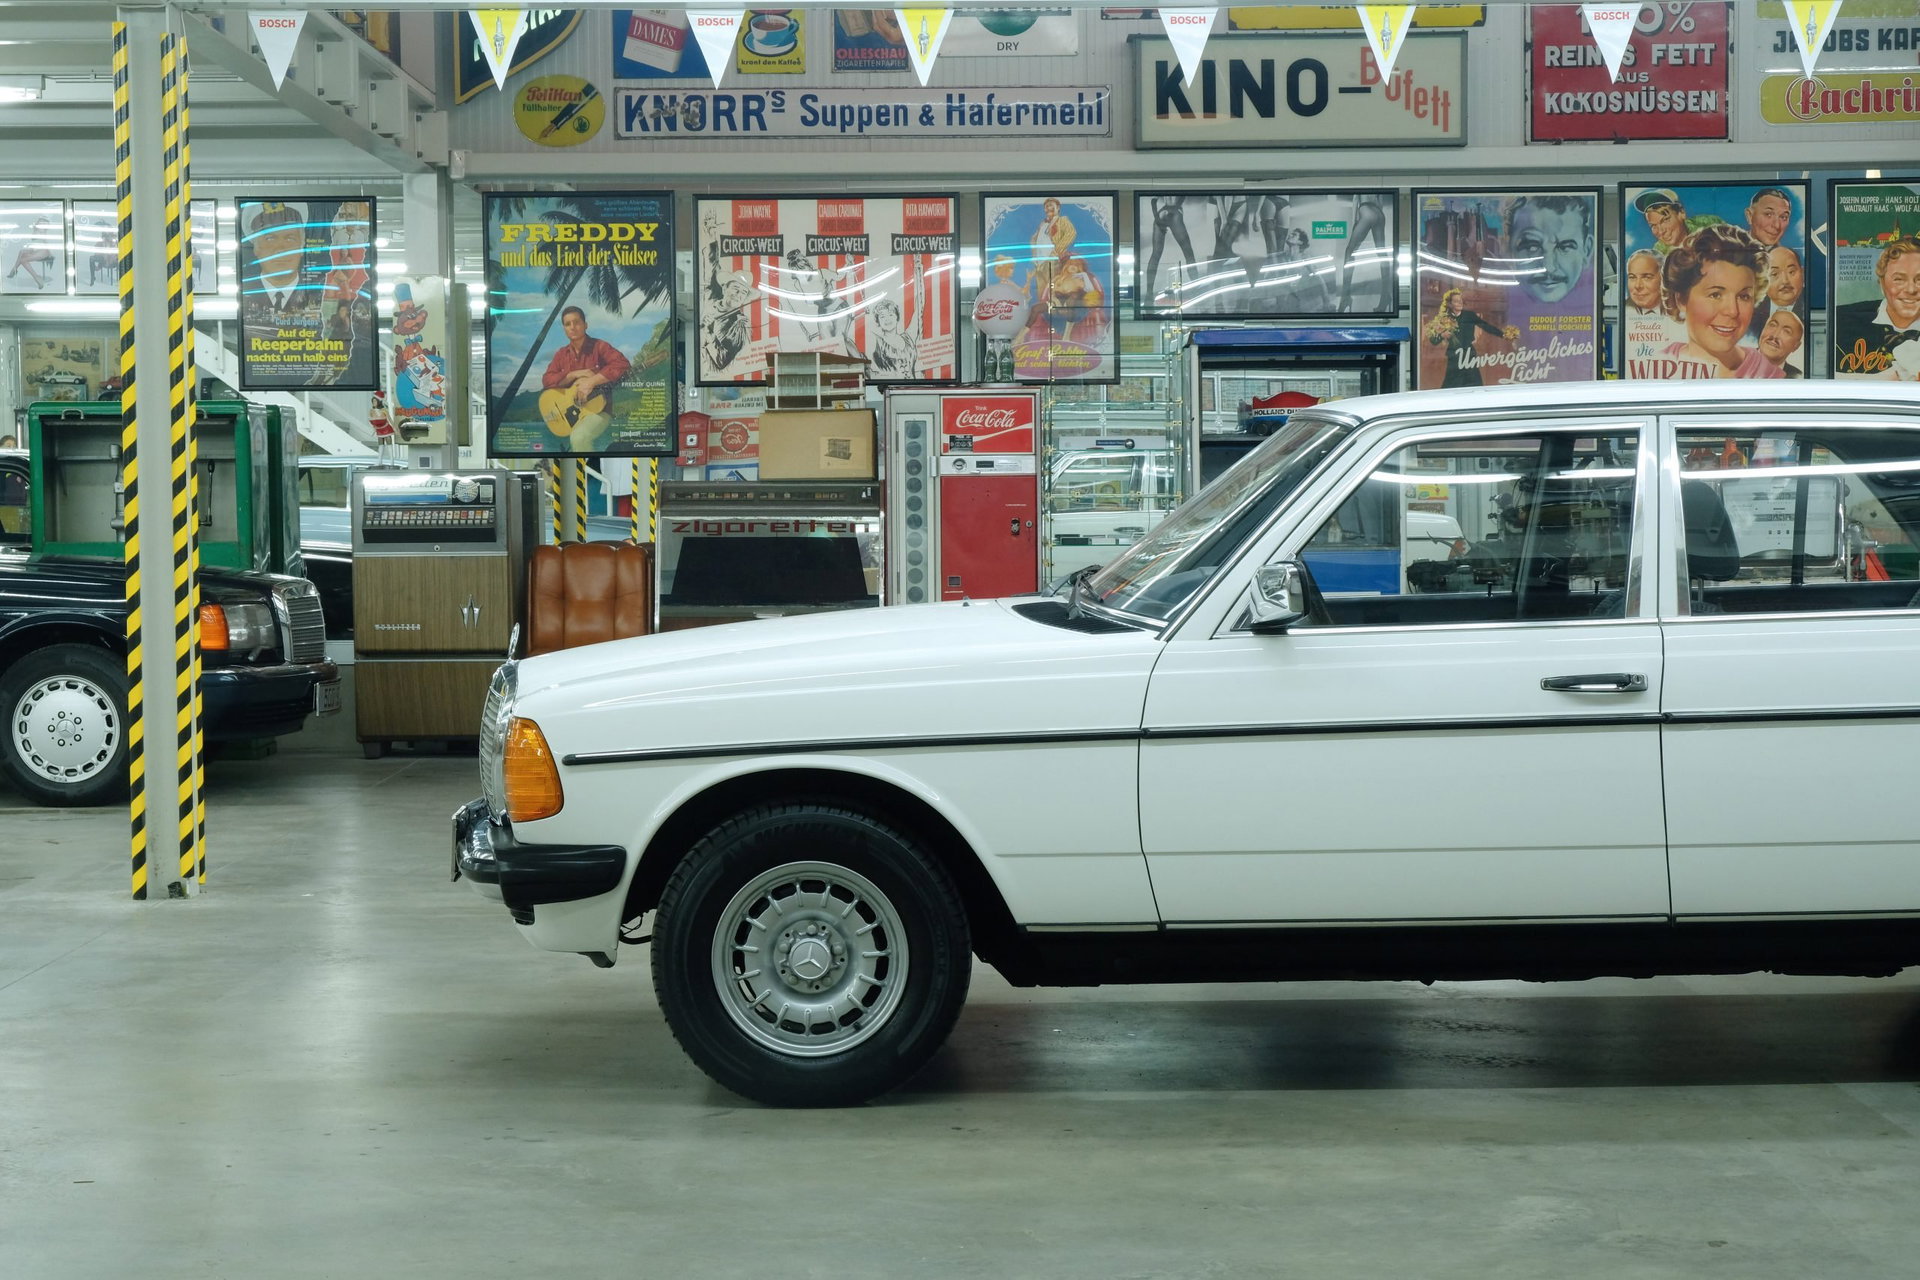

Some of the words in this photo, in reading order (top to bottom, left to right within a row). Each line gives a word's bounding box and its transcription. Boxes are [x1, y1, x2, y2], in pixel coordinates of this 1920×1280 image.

[698, 17, 734, 26] BOSCH
[1170, 16, 1206, 24] BOSCH
[1576, 2, 1695, 34] 10%
[1594, 12, 1629, 20] BOSCH
[259, 19, 296, 28] BOSCH
[633, 20, 677, 46] DAMES
[997, 41, 1019, 51] DRY
[1773, 29, 1870, 52] JAOBS
[836, 47, 906, 60] OLLESCHAU
[1545, 44, 1636, 67] REINS
[1651, 43, 1716, 65] FETT
[836, 59, 907, 68] ZIGARETTENPAPIER
[1615, 72, 1649, 83] AUS
[527, 86, 582, 102] Pelikan
[1545, 86, 1717, 114] KOKOSNÜSSEN
[522, 103, 562, 112] Füllhalter
[800, 94, 909, 133] Suppen
[918, 103, 935, 126] &
[946, 92, 1103, 127] Hafermehl
[1860, 196, 1880, 204] KIPPER
[1885, 195, 1902, 204] HANS
[1905, 195, 1919, 204] HOLT
[738, 204, 752, 219] JOHN
[753, 204, 771, 219] WAYNE
[905, 203, 918, 217] RITA
[919, 203, 946, 217] HAYWORTH
[1874, 204, 1889, 213] HAAS
[1894, 204, 1911, 213] WOLF
[500, 223, 659, 242] FREDDY
[501, 244, 525, 267] und
[529, 244, 552, 267] das
[557, 243, 584, 267] Lied
[588, 243, 611, 267] der
[613, 243, 658, 267] Südsee
[275, 317, 291, 326] Curd
[292, 316, 319, 328] Jürgens
[1529, 316, 1556, 324] RUDOLF
[1634, 321, 1661, 330] Paula
[277, 328, 297, 337] Auf
[299, 328, 317, 337] der
[1629, 332, 1664, 342] WESSELY
[251, 338, 344, 353] Reeperbahn
[246, 353, 281, 362] nachts
[283, 354, 301, 362] um
[303, 353, 326, 362] halb
[327, 353, 349, 362] eins
[1455, 336, 1593, 370] Unvergängliches
[1498, 362, 1555, 384] Licht
[956, 409, 1017, 429] Coca-Cola
[672, 519, 870, 536] zigaretten
